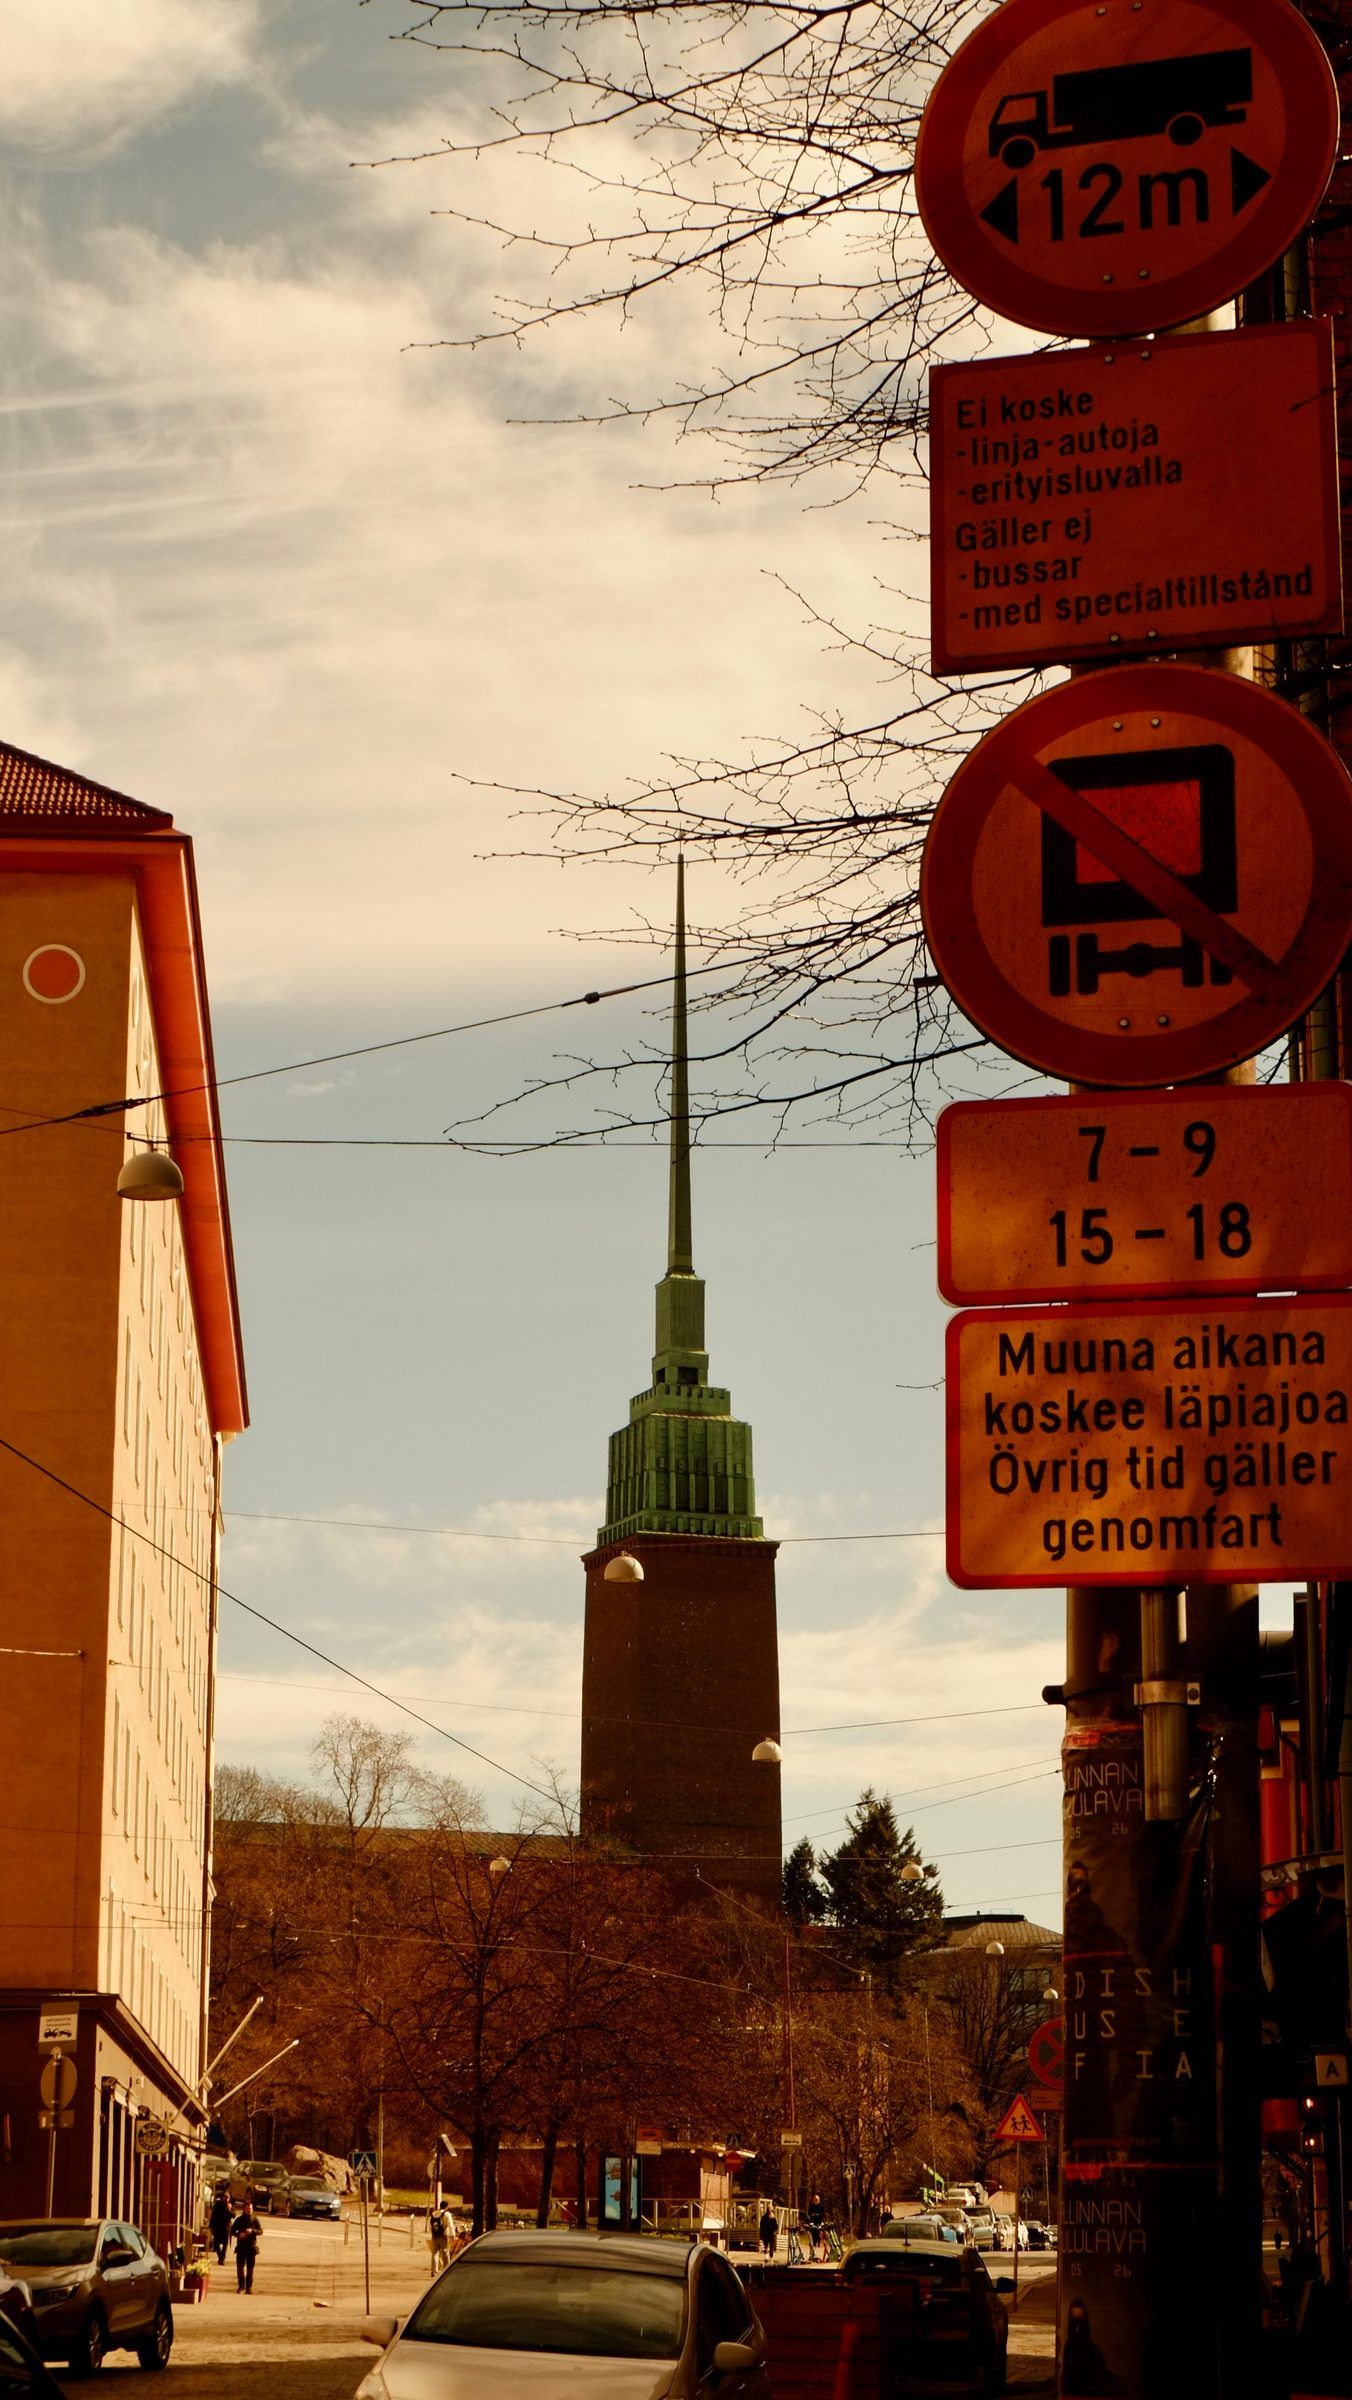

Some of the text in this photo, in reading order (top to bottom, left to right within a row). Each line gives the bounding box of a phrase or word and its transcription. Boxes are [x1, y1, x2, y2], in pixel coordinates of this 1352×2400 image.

[956, 388, 1094, 430] Ei koske
[955, 418, 1159, 468] -linja-autoja
[955, 455, 1183, 506] -erityisluvalla
[953, 508, 1092, 552] Gäller ej
[957, 556, 1084, 590] -bussar
[957, 563, 1314, 630] -med specialtillstånd
[999, 1324, 1326, 1377] Muuna aikana
[984, 1381, 1349, 1437] koskee läpiajoa
[988, 1441, 1338, 1500] Övrig tid gäller
[1042, 1502, 1283, 1561] genomfart
[1063, 1968, 1192, 2000] DISH
[1326, 2061, 1340, 2079] A
